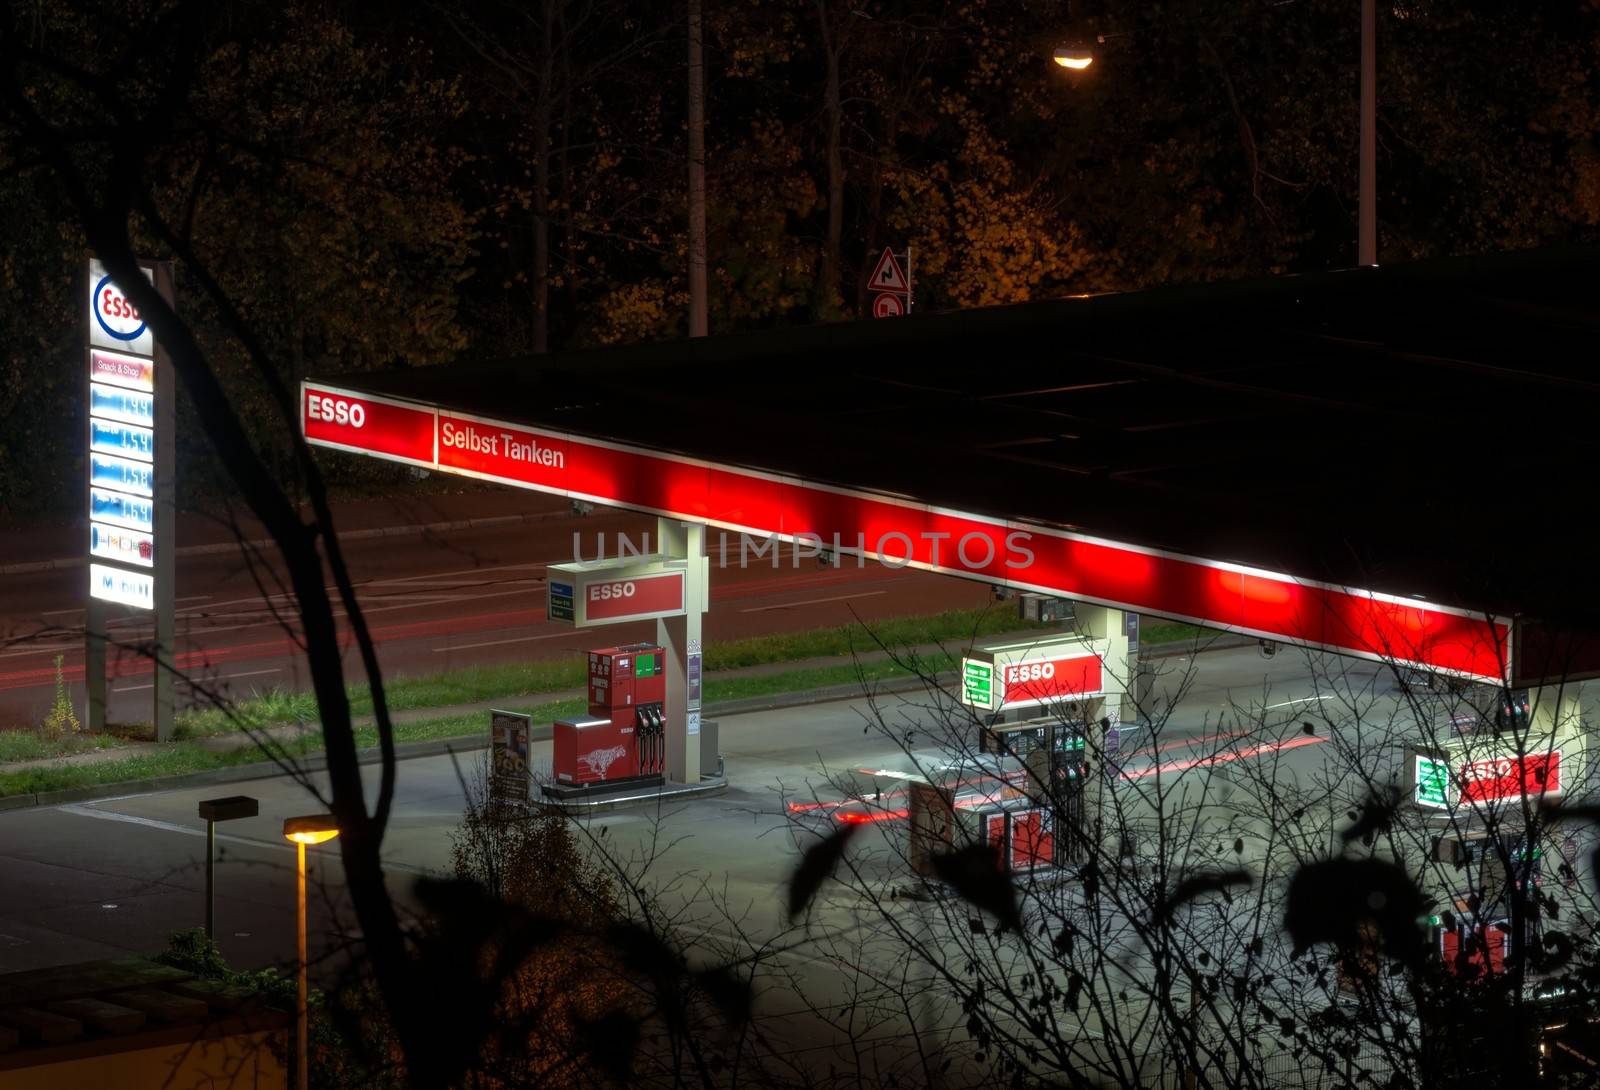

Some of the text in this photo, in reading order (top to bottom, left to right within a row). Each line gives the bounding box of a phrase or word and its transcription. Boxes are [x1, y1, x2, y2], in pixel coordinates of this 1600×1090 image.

[97, 359, 116, 372] Snack
[123, 365, 140, 378] Shop
[308, 395, 365, 428] ESSO
[442, 422, 564, 469] Selbst Tanken
[590, 582, 636, 601] ESSO
[1008, 662, 1055, 684] ESSO
